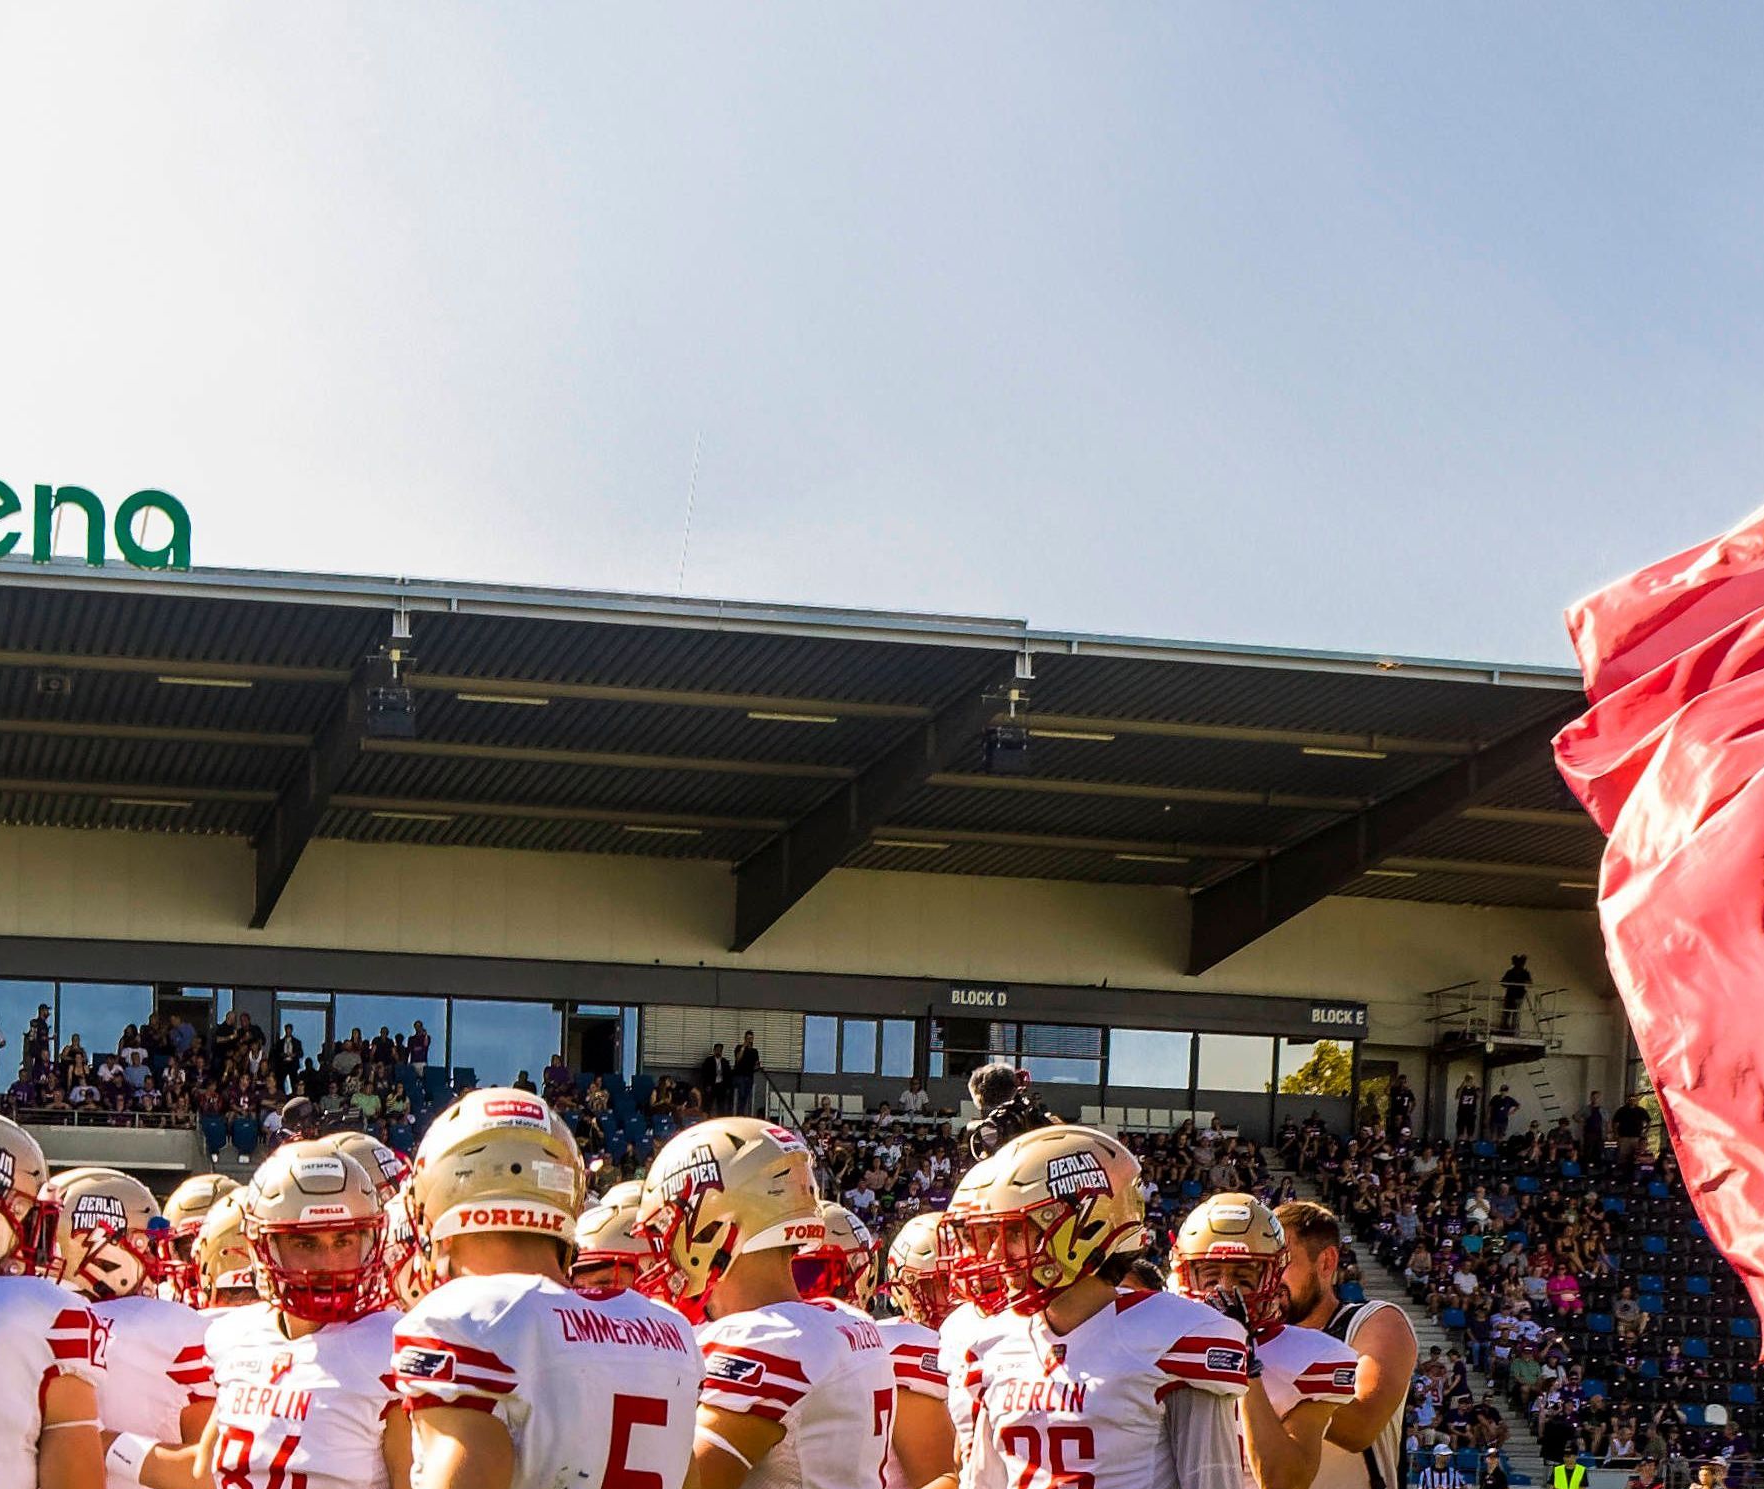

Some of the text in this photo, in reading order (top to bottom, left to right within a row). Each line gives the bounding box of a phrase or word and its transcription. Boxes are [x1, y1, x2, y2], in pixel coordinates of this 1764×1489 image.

[951, 990, 1007, 1007] BLOCK D
[1312, 1008, 1364, 1025] BLOCK E
[1049, 1153, 1099, 1179] BERLIN
[1048, 1169, 1109, 1199] THUNDER
[79, 1195, 123, 1215] BERLIN
[458, 1208, 566, 1232] FORELLE
[551, 1308, 688, 1355] ZIMMERMANN
[232, 1386, 313, 1422] BERLIN
[1002, 1379, 1087, 1413] BERLIN
